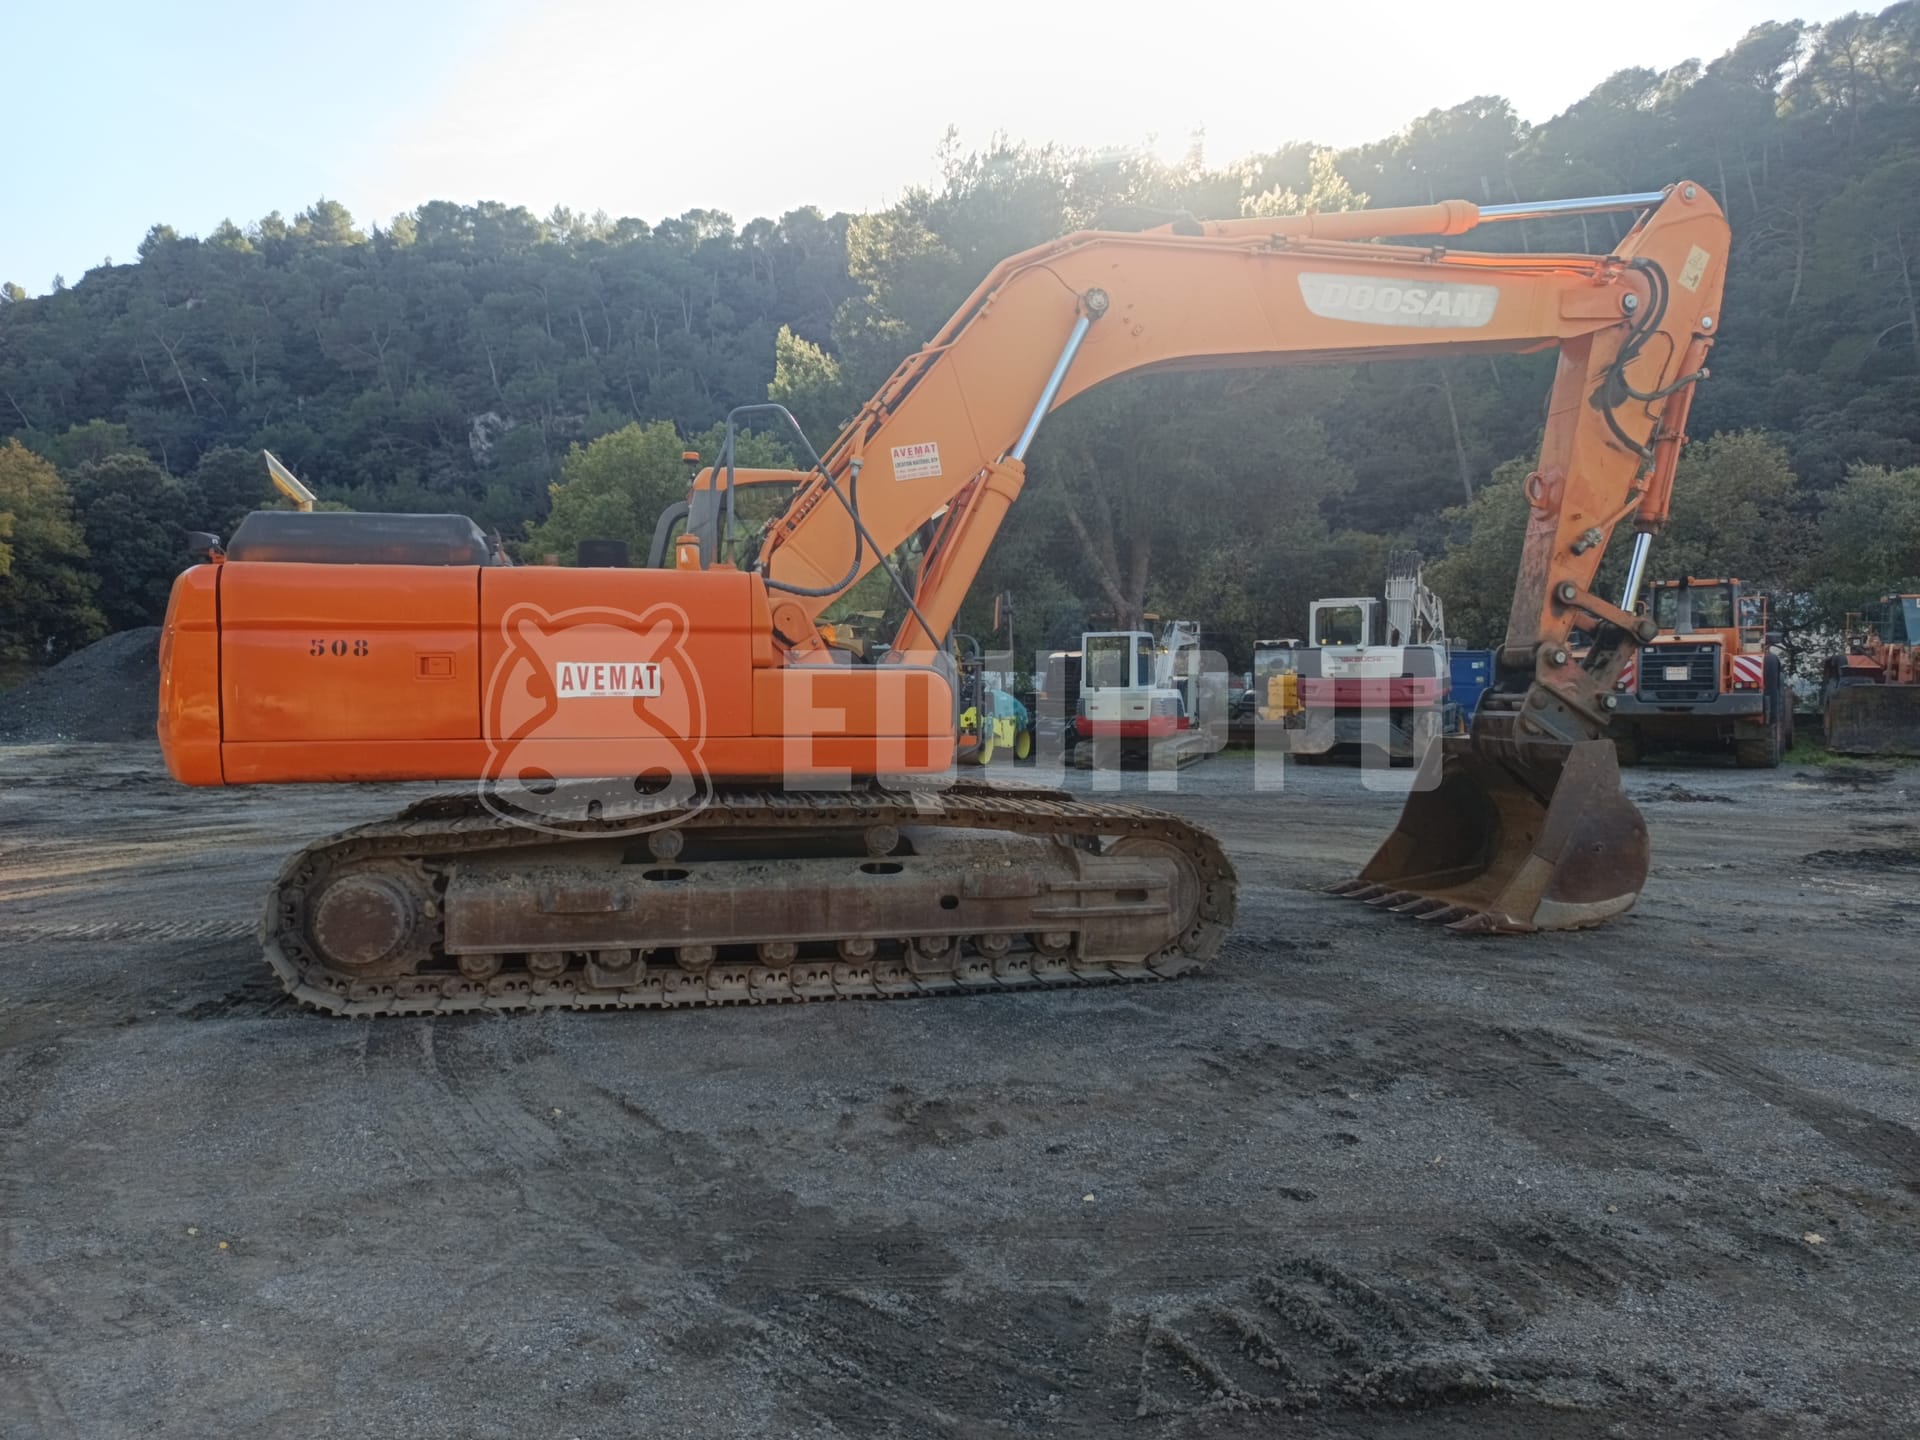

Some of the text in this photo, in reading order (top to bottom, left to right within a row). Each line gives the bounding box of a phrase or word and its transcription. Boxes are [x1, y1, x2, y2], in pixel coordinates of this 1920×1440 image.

[1320, 283, 1481, 317] DOOSAN
[893, 444, 935, 458] AVEMAT
[310, 639, 369, 657] 508
[561, 665, 657, 690] AVEMAT
